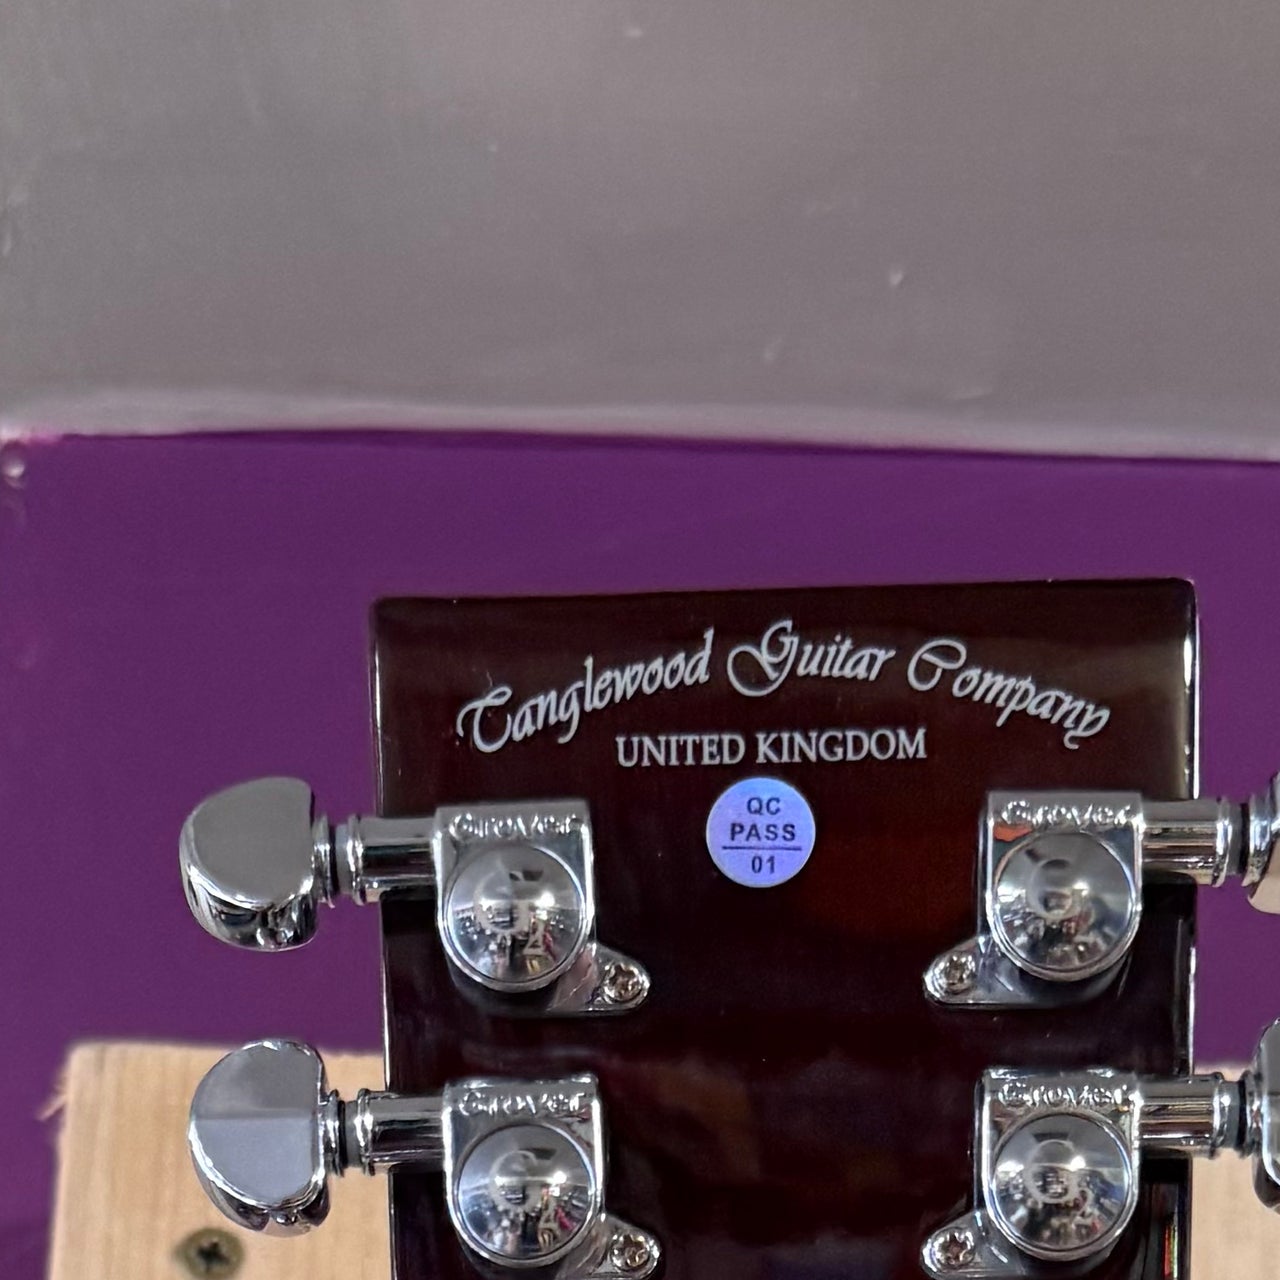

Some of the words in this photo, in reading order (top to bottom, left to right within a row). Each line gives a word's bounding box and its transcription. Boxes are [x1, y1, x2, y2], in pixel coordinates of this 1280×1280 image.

[455, 627, 714, 754] Tanglewood
[727, 619, 895, 697] Guitar
[908, 637, 1111, 750] Company
[616, 734, 746, 769] UNITED
[756, 728, 928, 764] KINGDOM
[746, 795, 782, 818] QC
[729, 821, 798, 844] PASS
[750, 854, 778, 875] 01
